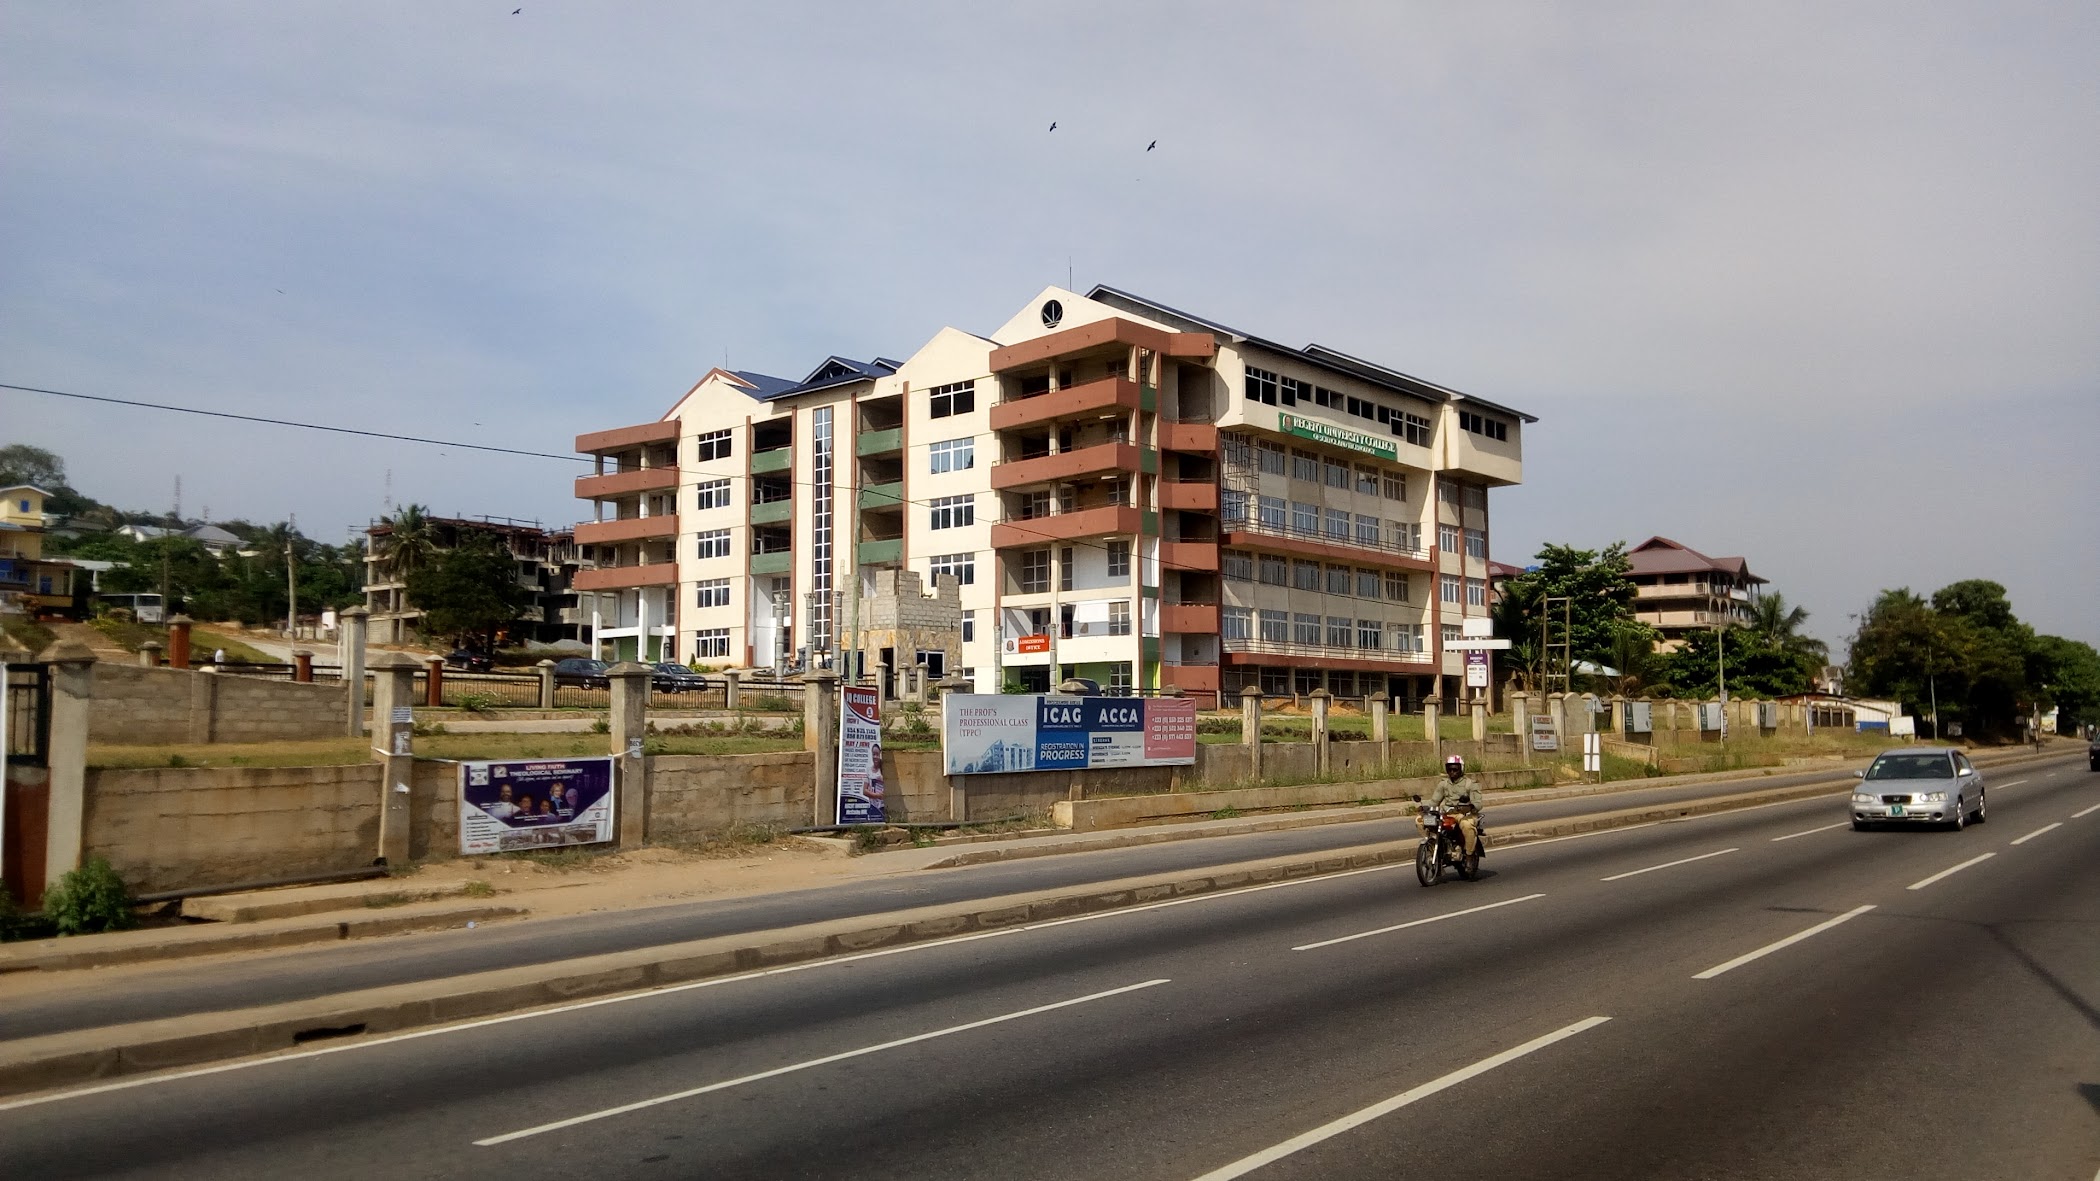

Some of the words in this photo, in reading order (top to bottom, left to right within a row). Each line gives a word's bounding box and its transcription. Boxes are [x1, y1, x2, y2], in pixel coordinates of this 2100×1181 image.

[1293, 417, 1322, 434] REGENT
[1323, 425, 1364, 445] UNIVERSITY
[1364, 436, 1396, 452] COLLEGE
[853, 694, 877, 705] COLLEGE
[960, 708, 974, 716] THE
[975, 708, 997, 716] PROF'S
[1043, 707, 1082, 723] ICAG
[1099, 708, 1138, 723] ACCA
[960, 719, 1008, 727] PROFESSIONAL
[1008, 719, 1029, 727] CLASS
[960, 729, 982, 738] (TPPC)
[1040, 750, 1085, 760] PROGRESS
